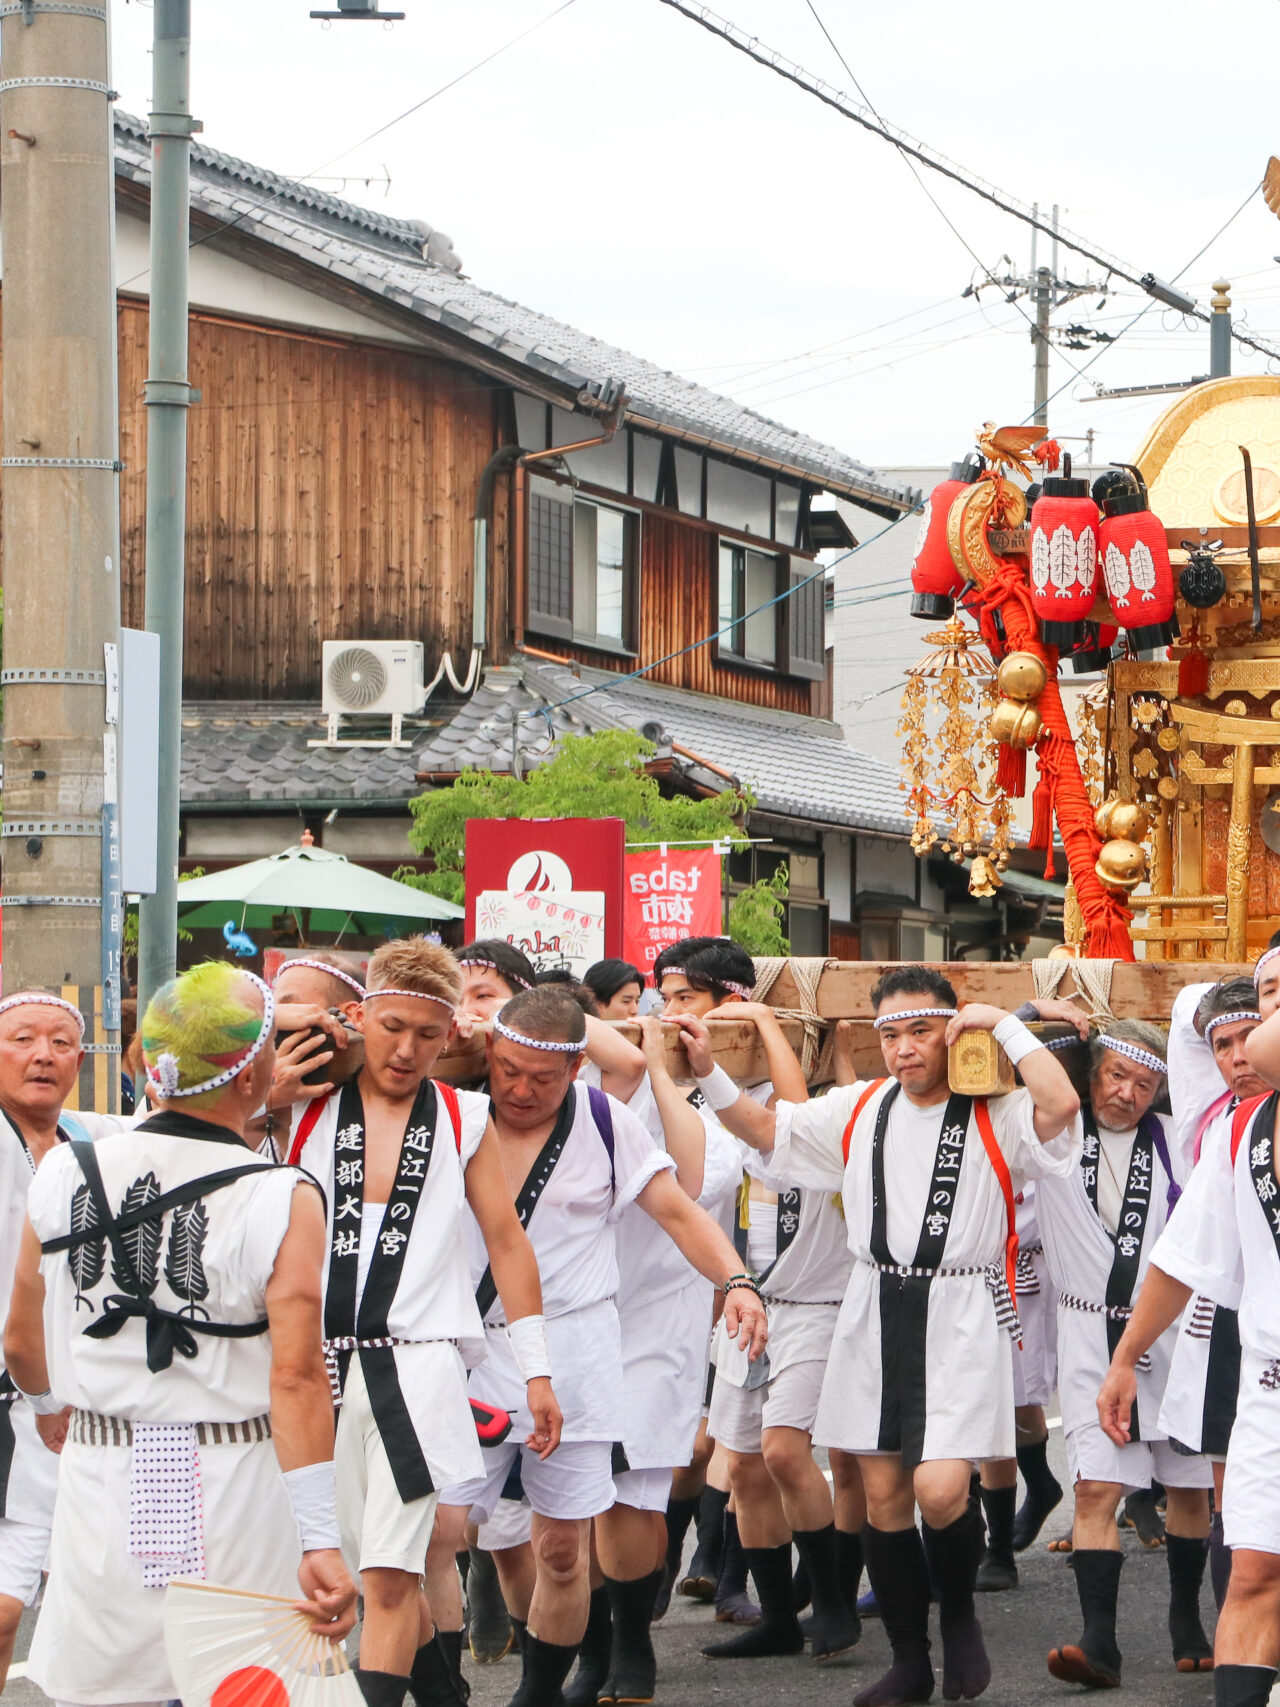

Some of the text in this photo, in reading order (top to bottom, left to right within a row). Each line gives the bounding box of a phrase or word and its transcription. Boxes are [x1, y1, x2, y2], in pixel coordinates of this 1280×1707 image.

[332, 1123, 364, 1257] 建部大社
[379, 1125, 431, 1256] 近江一の宮
[926, 1124, 965, 1236] 近江一の宮
[1117, 1147, 1151, 1257] 近江一の宮
